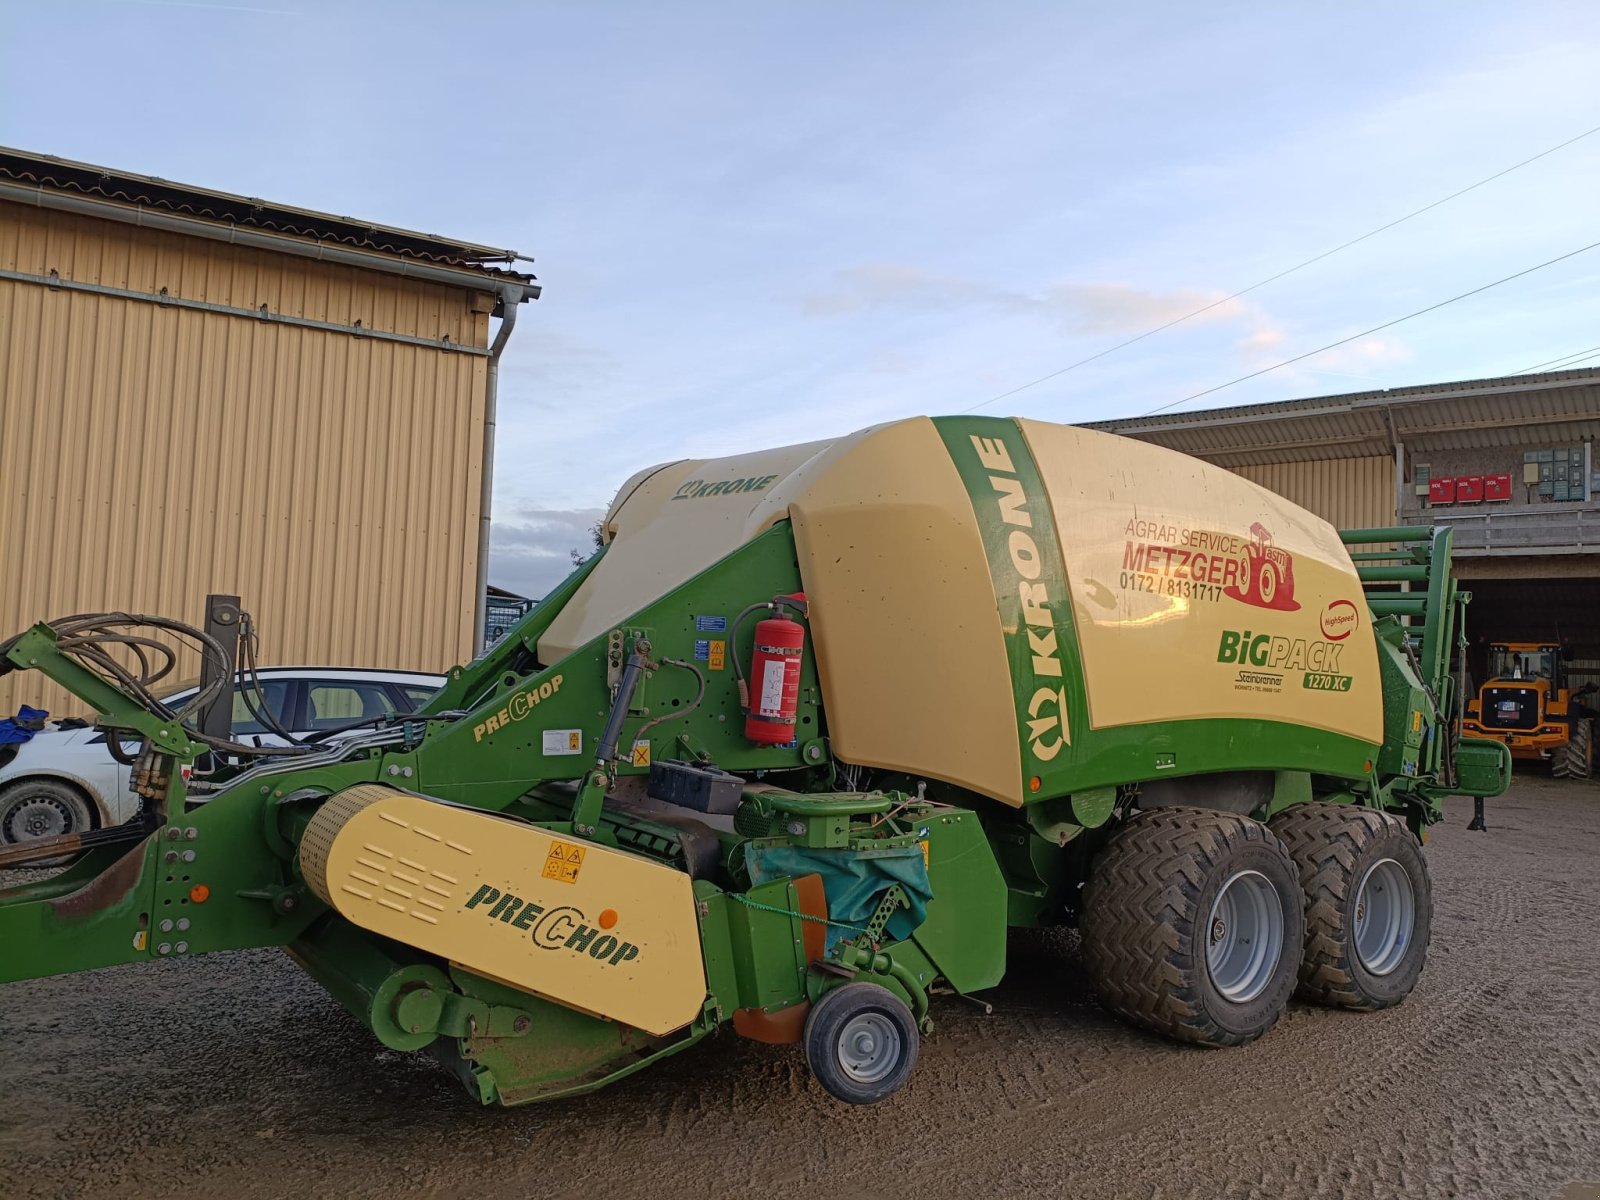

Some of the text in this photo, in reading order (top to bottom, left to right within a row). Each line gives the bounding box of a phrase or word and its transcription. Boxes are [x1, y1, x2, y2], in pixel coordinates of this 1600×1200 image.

[691, 475, 779, 498] KRONE
[1124, 519, 1239, 554] AGRAR SERVICE
[969, 435, 1063, 677] KRONE
[1122, 541, 1239, 587] METZGER
[1120, 572, 1154, 593] 0172
[1167, 578, 1223, 602] 8131717
[1324, 612, 1355, 627] HighSpeed
[1308, 674, 1348, 690] 1270 XC
[473, 674, 564, 743] PRECHOP
[464, 884, 640, 966] PRECHOP
